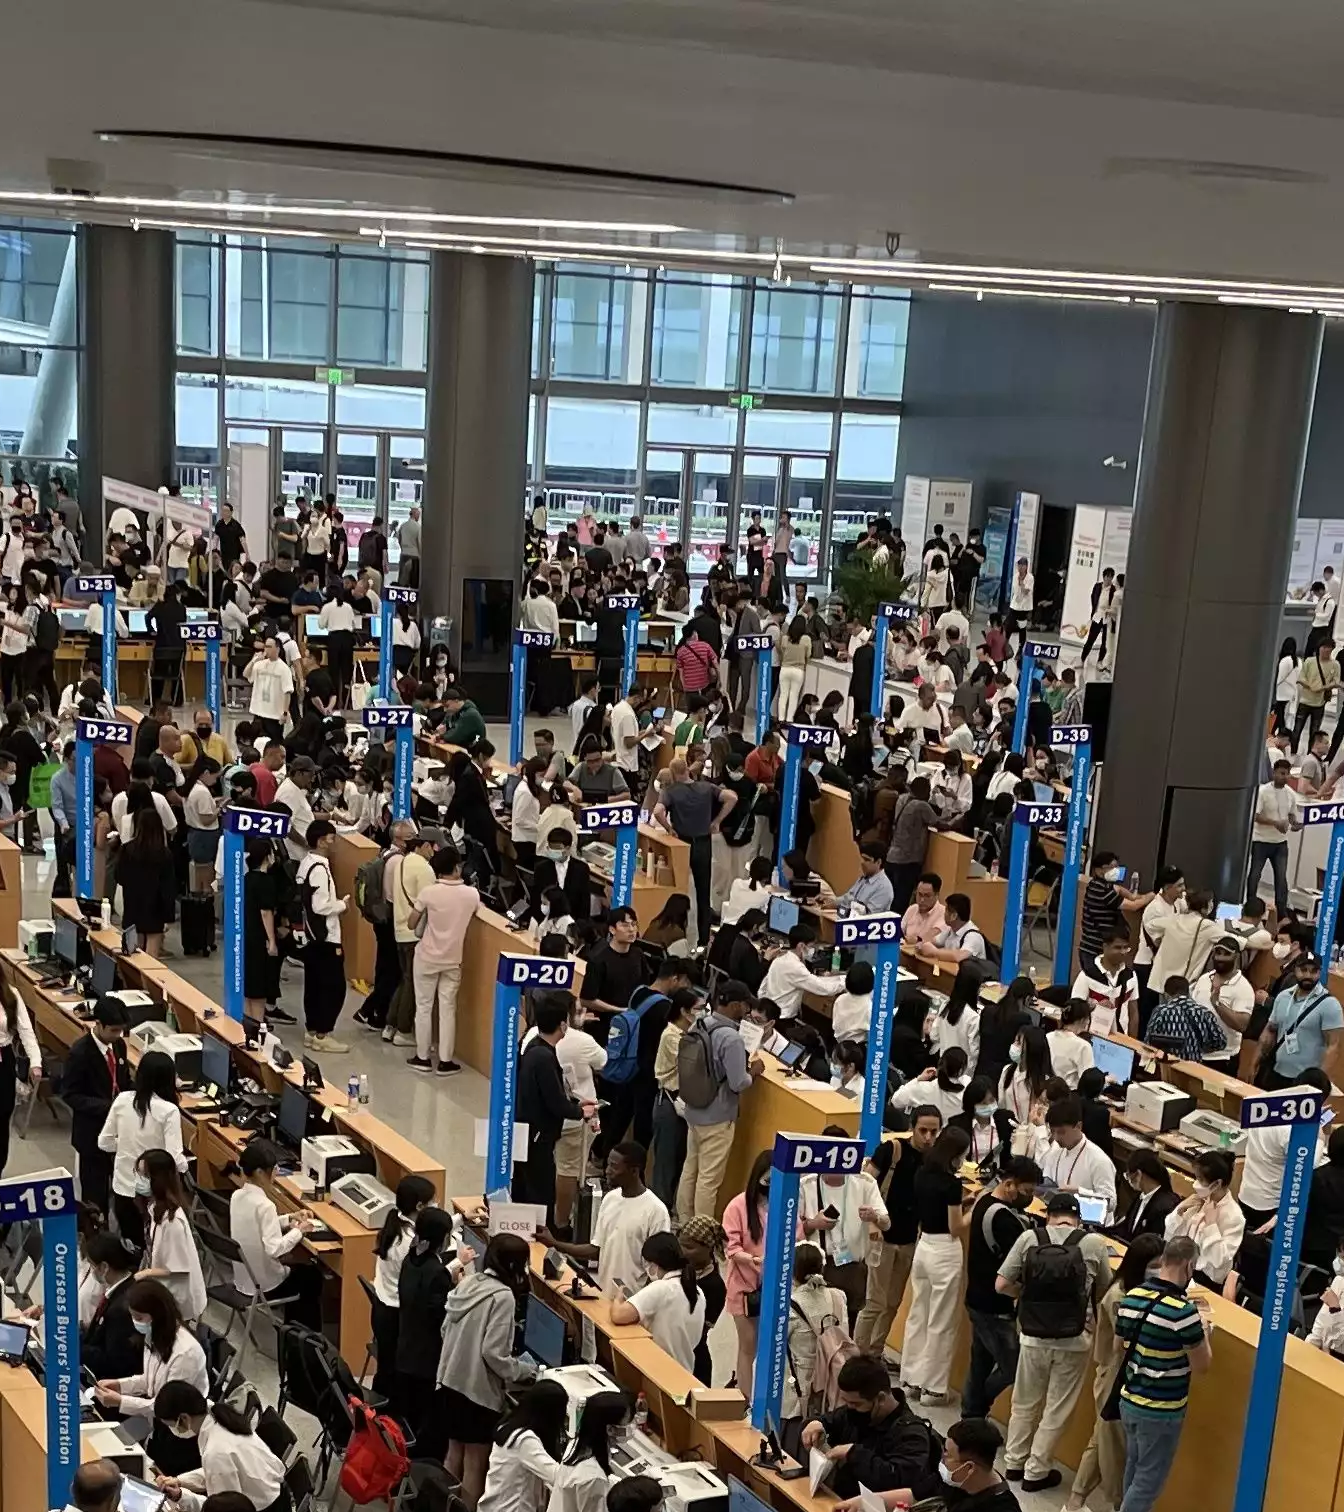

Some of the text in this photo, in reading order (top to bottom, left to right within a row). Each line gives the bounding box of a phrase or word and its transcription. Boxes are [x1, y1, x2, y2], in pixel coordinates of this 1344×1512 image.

[79, 579, 113, 591] D-25
[389, 590, 416, 602] D-36
[609, 598, 638, 609] D-37
[885, 606, 910, 618] D-44
[181, 626, 217, 639] D-26
[523, 633, 550, 646] D-35
[738, 638, 769, 649] D-38
[1034, 646, 1057, 657] D-43
[368, 711, 410, 725] D-27
[86, 724, 128, 742] D-22
[799, 730, 830, 744] D-34
[1053, 729, 1088, 742] D-39
[587, 809, 633, 826] D-28
[1028, 808, 1062, 822] D-33
[238, 814, 284, 835] D-21
[843, 922, 896, 941] D-29
[513, 963, 568, 984] D-20
[880, 961, 892, 1009] Overseas
[506, 1007, 516, 1058] Overseas
[869, 1051, 884, 1114] Registration
[1250, 1098, 1315, 1123] D-30
[500, 1105, 512, 1174] Registration
[794, 1146, 857, 1168] D-19
[500, 1221, 530, 1232] CLOSE
[782, 1198, 795, 1260] Overseas
[1270, 1146, 1309, 1331] Overseas Buyers' Registration
[54, 1244, 72, 1465] Overseas Buyers' Registration
[772, 1316, 786, 1398] Registration
